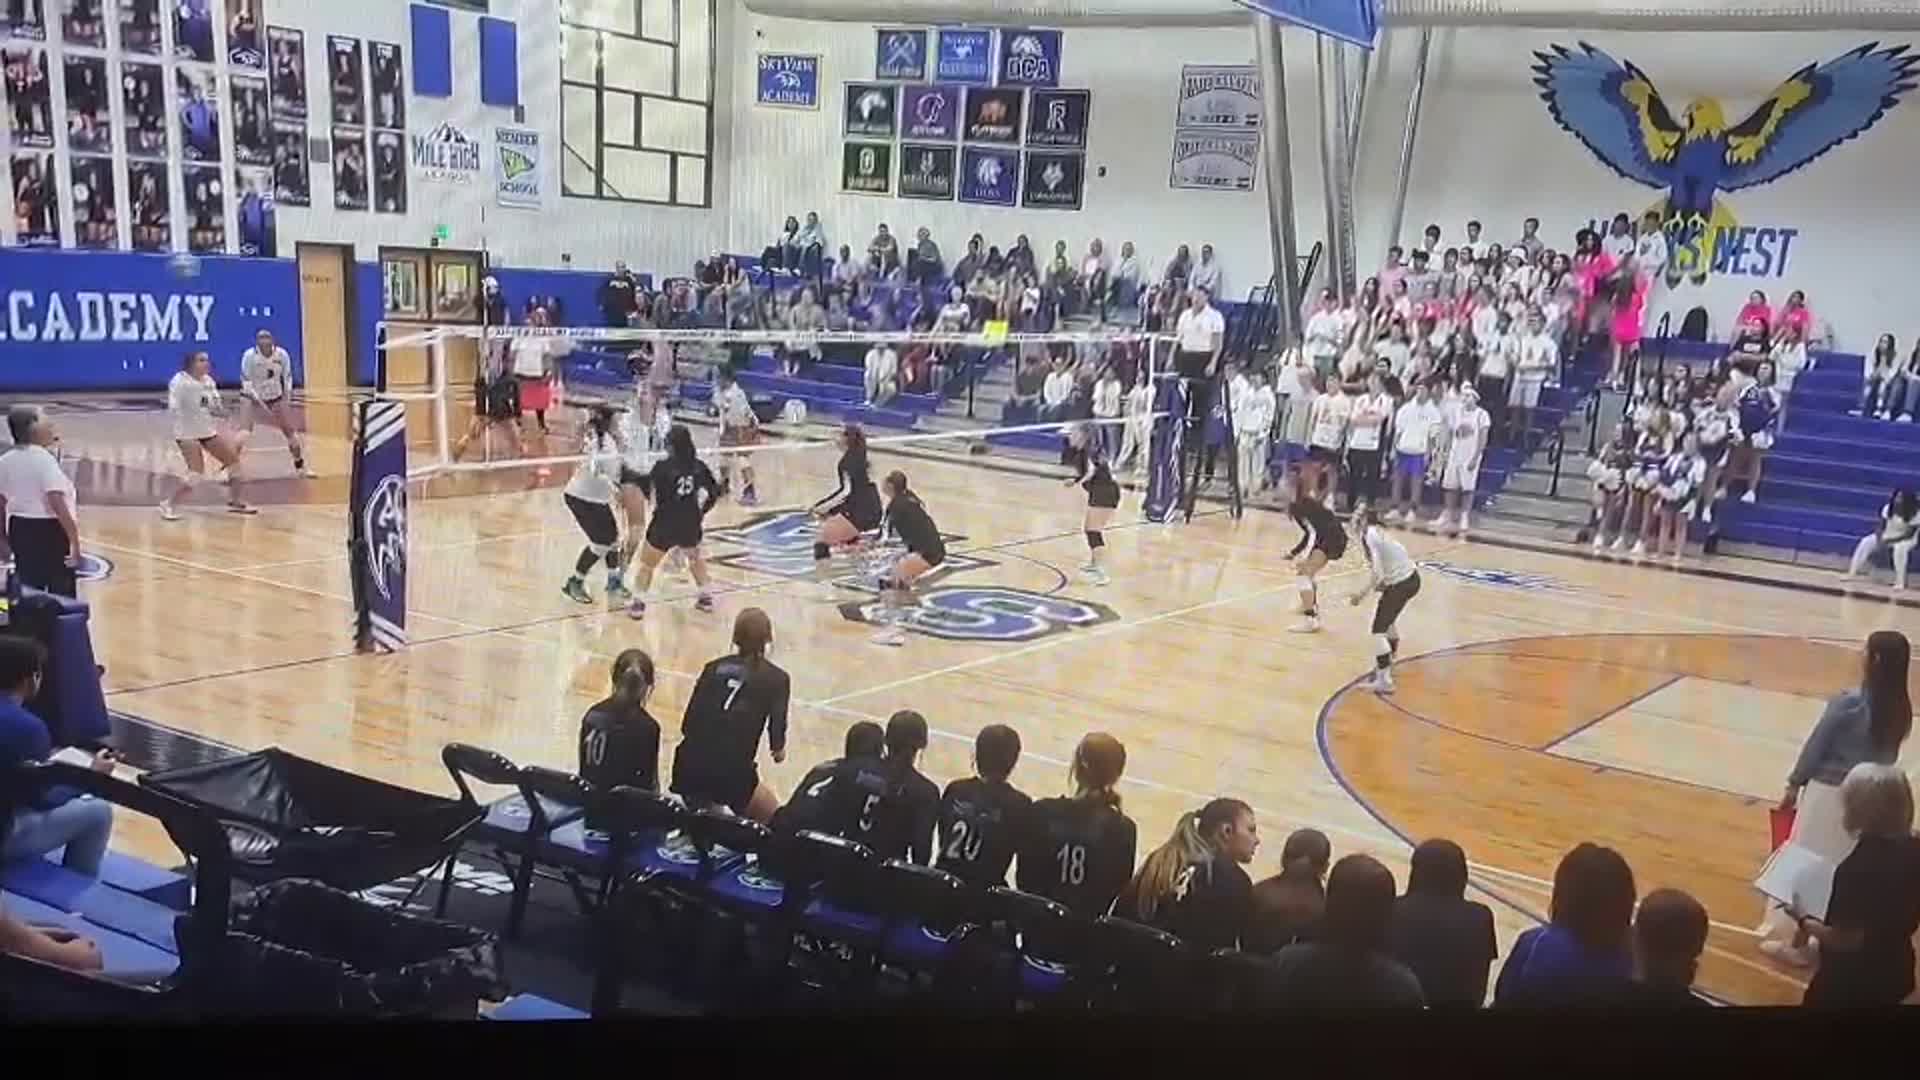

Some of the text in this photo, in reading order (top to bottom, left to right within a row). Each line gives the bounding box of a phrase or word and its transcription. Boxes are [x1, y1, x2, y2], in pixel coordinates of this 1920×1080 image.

[411, 135, 447, 167] MILE
[449, 142, 480, 170] HIGH
[500, 183, 538, 195] SCHOOL
[1712, 227, 1797, 277] NEST
[0, 290, 214, 342] CADEMY
[723, 678, 743, 711] 7
[584, 728, 608, 766] 10
[1057, 844, 1086, 885] 18
